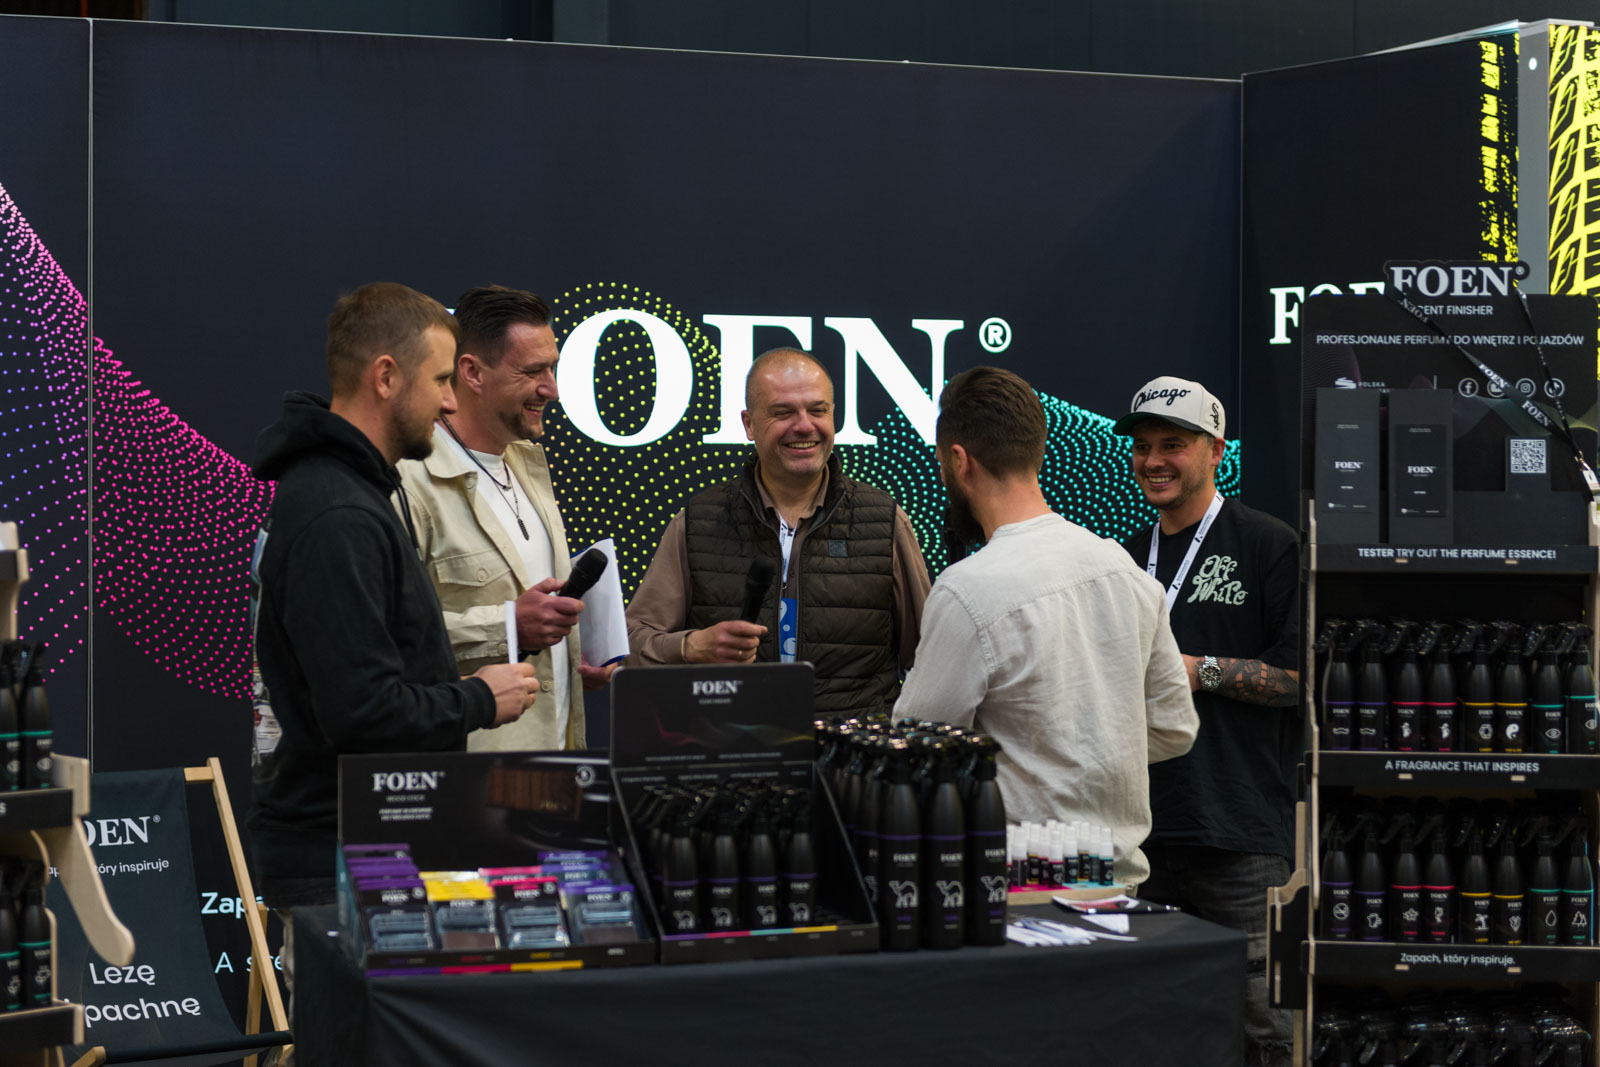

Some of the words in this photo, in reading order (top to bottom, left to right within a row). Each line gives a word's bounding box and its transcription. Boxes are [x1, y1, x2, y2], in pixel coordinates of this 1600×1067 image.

[1446, 305, 1494, 315] FINISHER
[1316, 334, 1402, 345] PROFESJONALNE
[1454, 335, 1471, 345] DO
[1472, 335, 1515, 347] WNĘTRZ
[1133, 388, 1192, 412] Chicago
[1358, 548, 1394, 558] TESTER
[1397, 548, 1415, 558] TRY
[1416, 549, 1439, 558] OUT
[1440, 549, 1459, 558] THE
[1461, 549, 1507, 559] PERFUME
[1508, 549, 1557, 559] ESSENCE!
[1384, 760, 1394, 770] A
[1395, 761, 1460, 771] FRAGRANCE
[1463, 761, 1490, 771] THAT
[1492, 762, 1540, 772] INSPIRES
[119, 857, 170, 875] inspiruje
[214, 951, 234, 974] A
[1400, 952, 1441, 966] Zapach,
[1443, 953, 1469, 967] który
[1471, 954, 1516, 967] inspiruje.
[89, 962, 156, 986] Lezę
[84, 996, 201, 1028] pachnę
